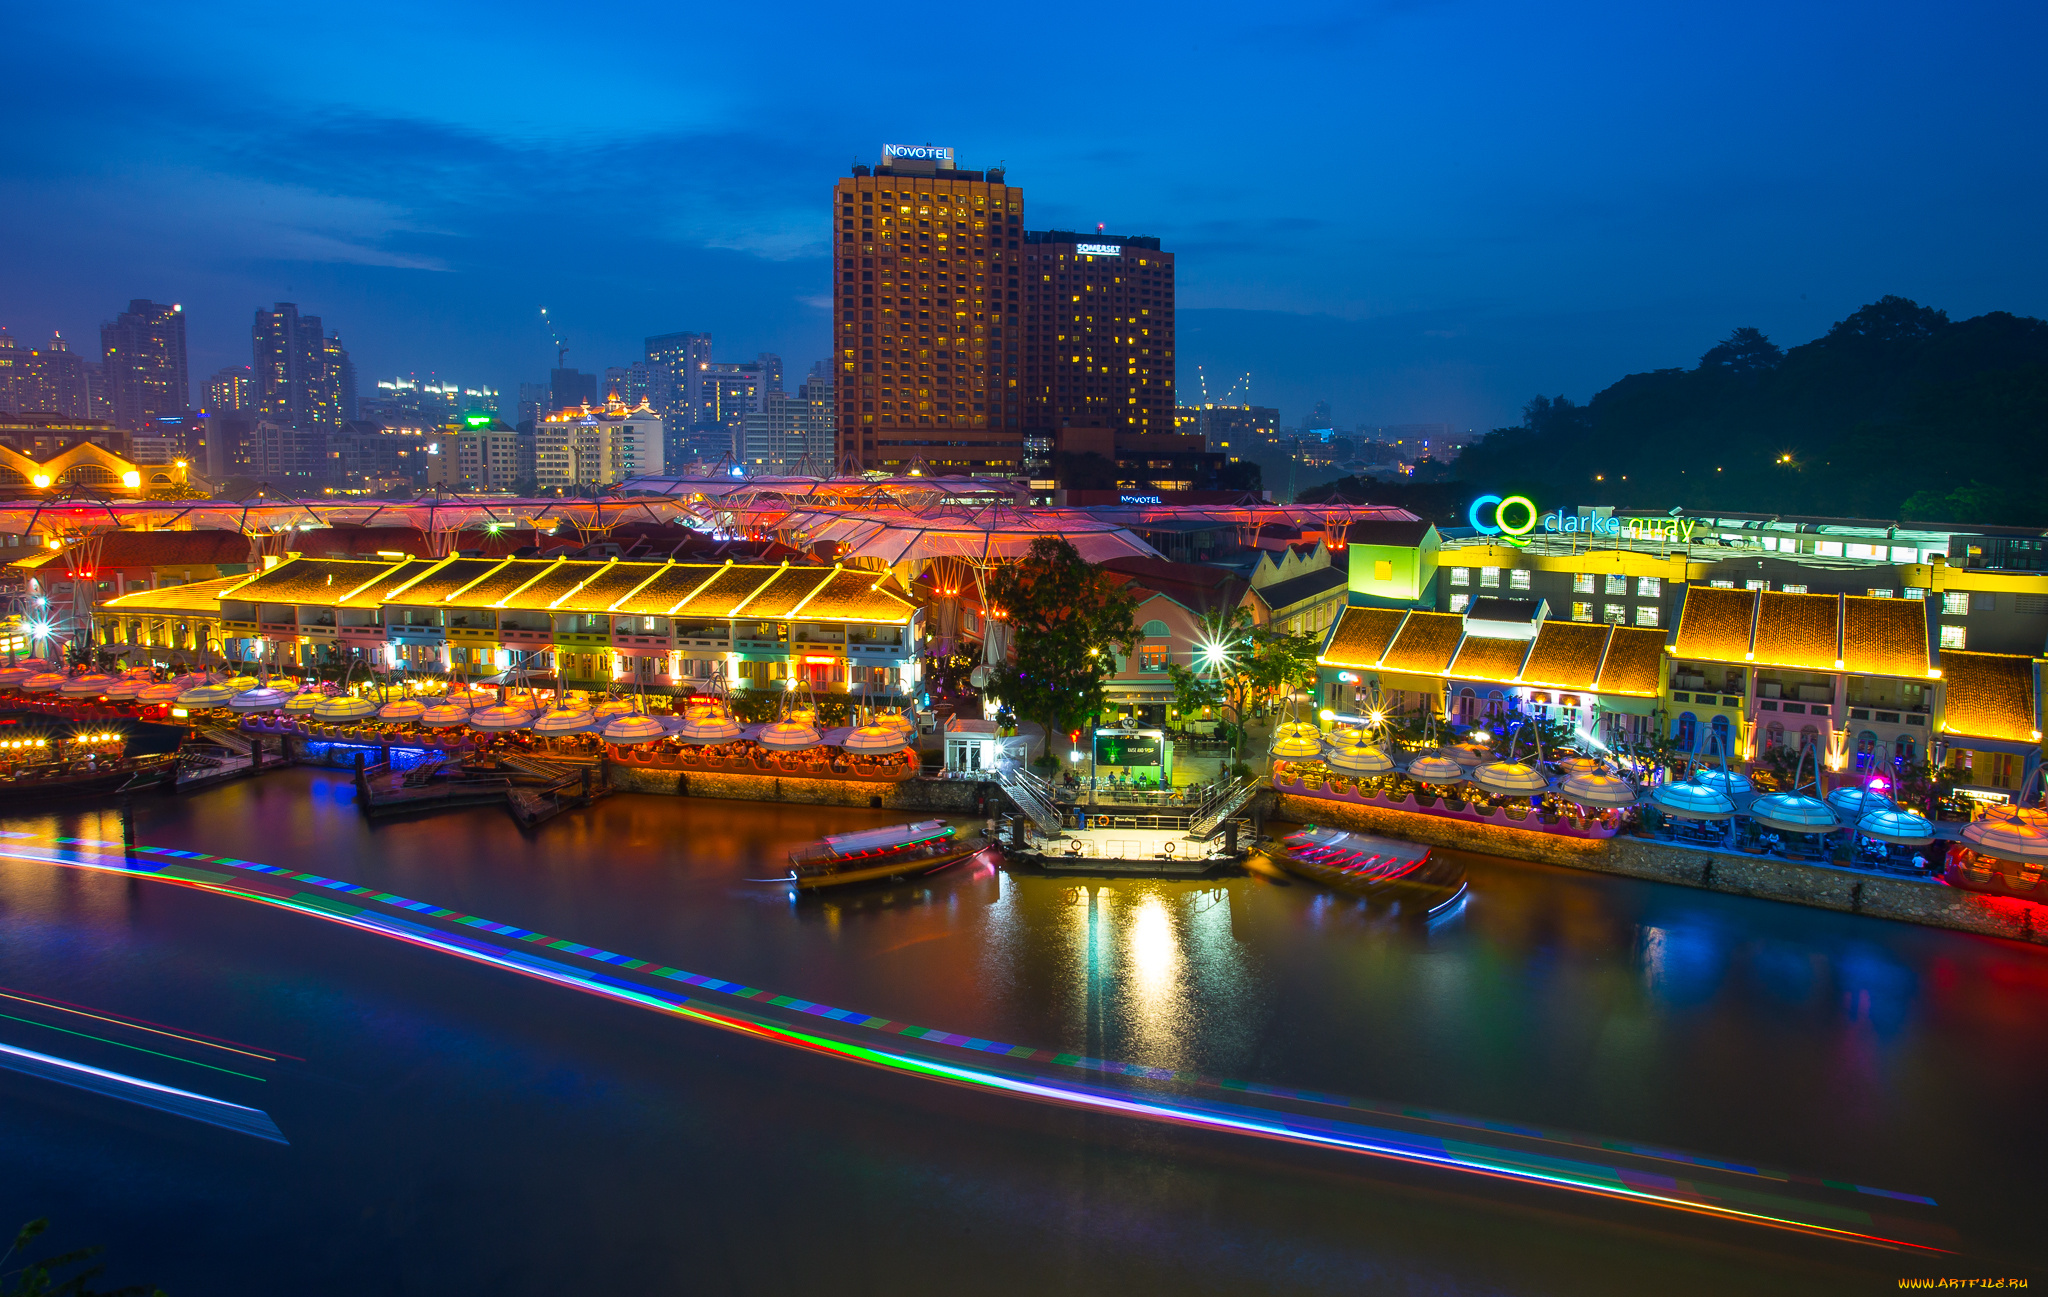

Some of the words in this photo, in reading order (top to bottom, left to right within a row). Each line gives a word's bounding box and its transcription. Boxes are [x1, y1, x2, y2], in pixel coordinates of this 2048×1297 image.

[885, 144, 952, 160] NOVOTEL
[1076, 243, 1121, 253] SOMERSET
[1121, 495, 1162, 504] NOVOTEL
[1544, 509, 1620, 534] clarke
[1628, 517, 1696, 543] quay
